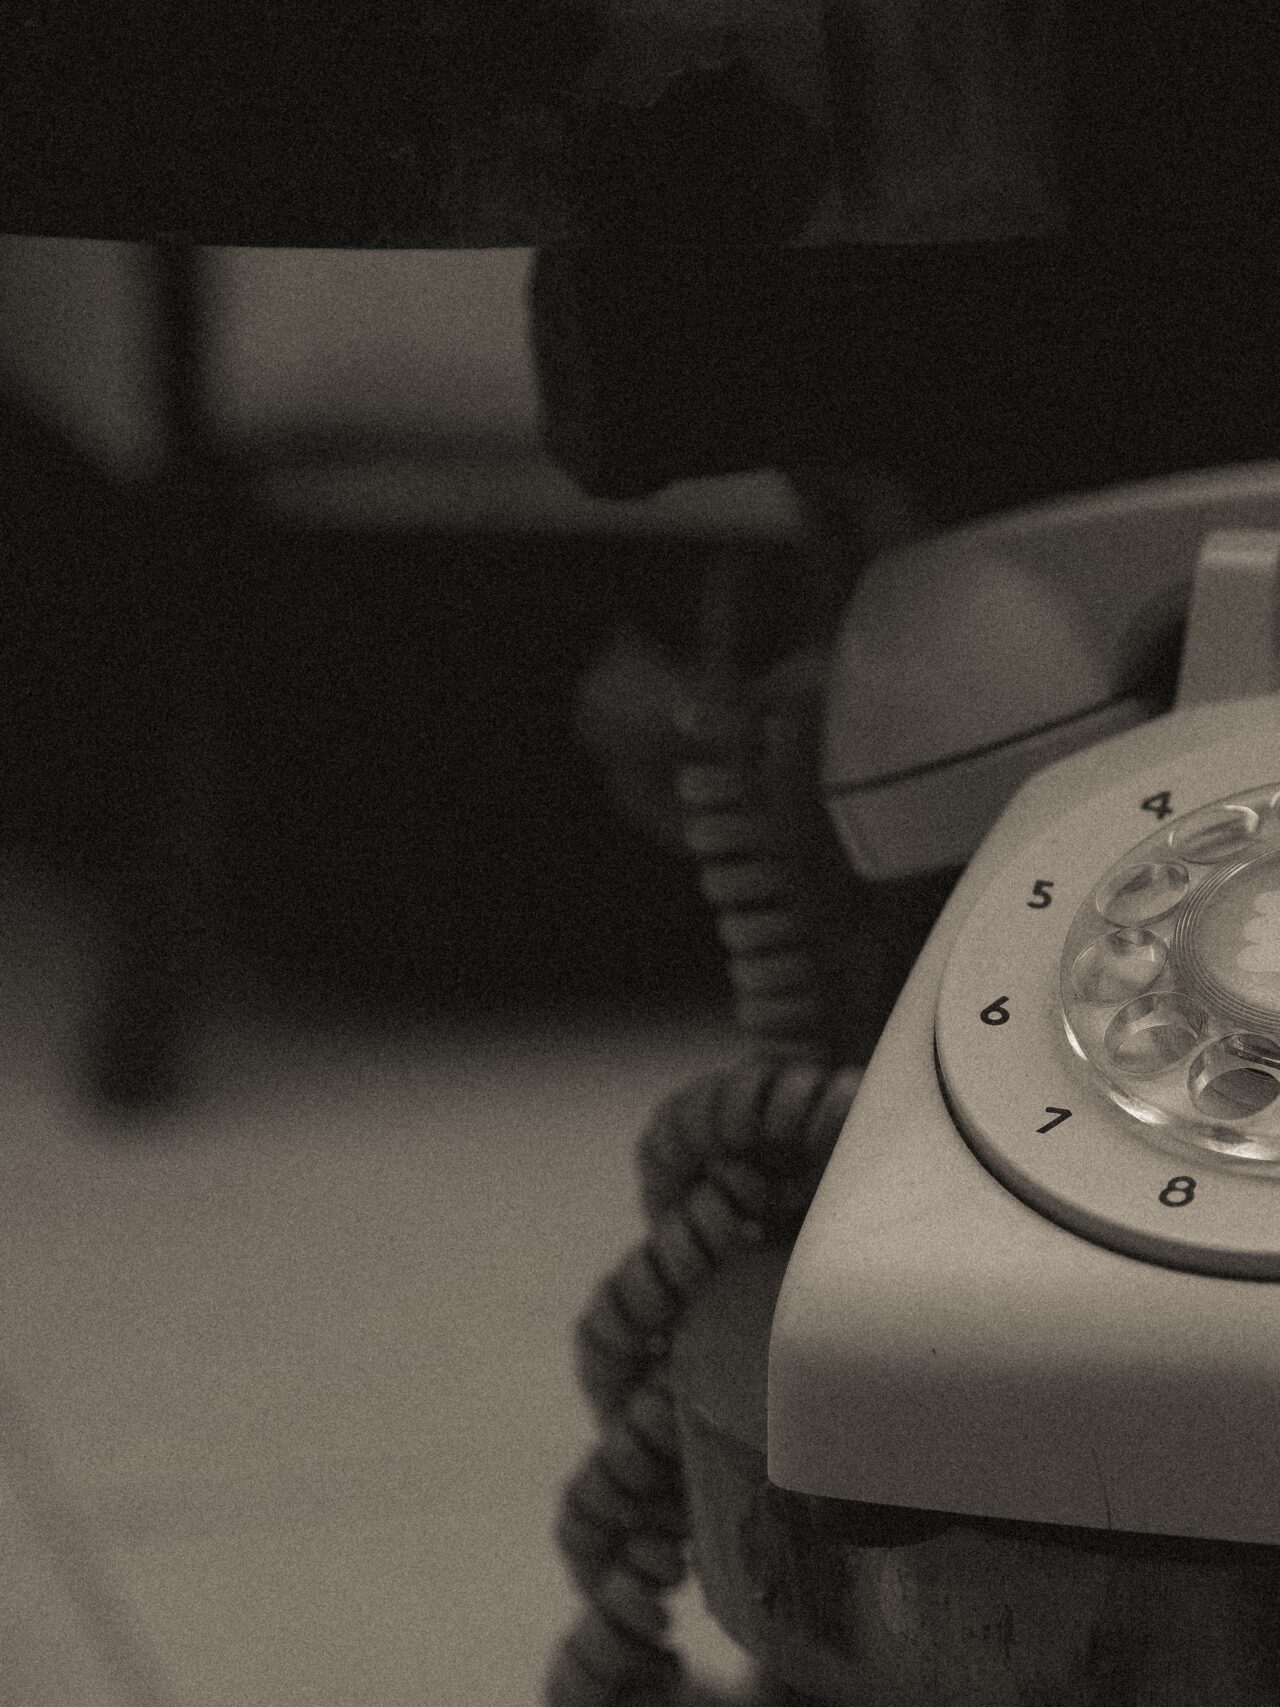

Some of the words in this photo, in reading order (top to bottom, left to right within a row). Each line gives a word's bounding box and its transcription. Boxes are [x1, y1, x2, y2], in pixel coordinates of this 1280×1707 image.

[1140, 791, 1174, 820] 4
[1027, 879, 1054, 910] 5
[979, 995, 1010, 1026] 6
[1037, 1106, 1073, 1134] 7
[1158, 1175, 1197, 1208] 8
